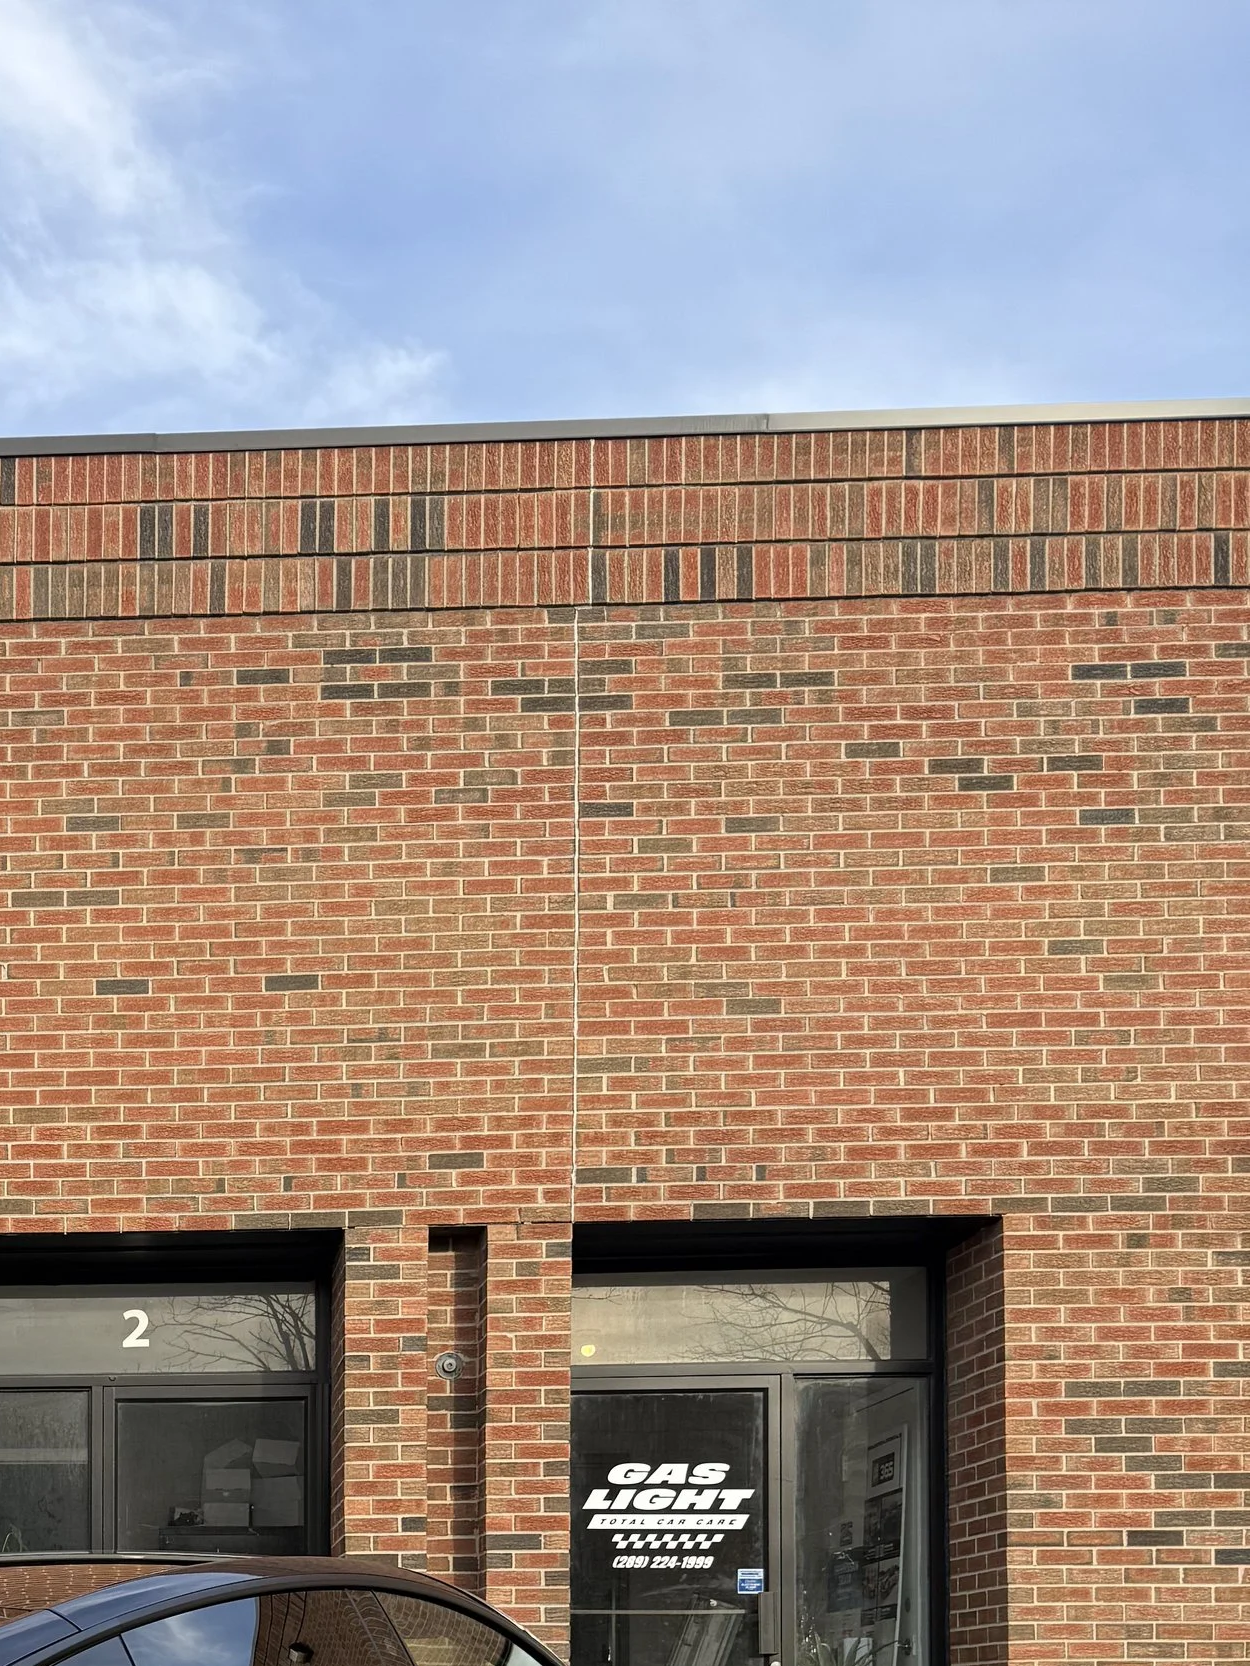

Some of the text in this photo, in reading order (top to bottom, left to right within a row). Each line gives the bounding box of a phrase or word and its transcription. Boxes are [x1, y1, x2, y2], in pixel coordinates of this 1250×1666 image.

[122, 1308, 149, 1348] 2
[607, 1462, 731, 1485] GAS
[581, 1488, 756, 1511] LIGHT
[599, 1518, 738, 1526] TOTAL CAR CARE
[612, 1555, 715, 1570] (289) 224-1999
